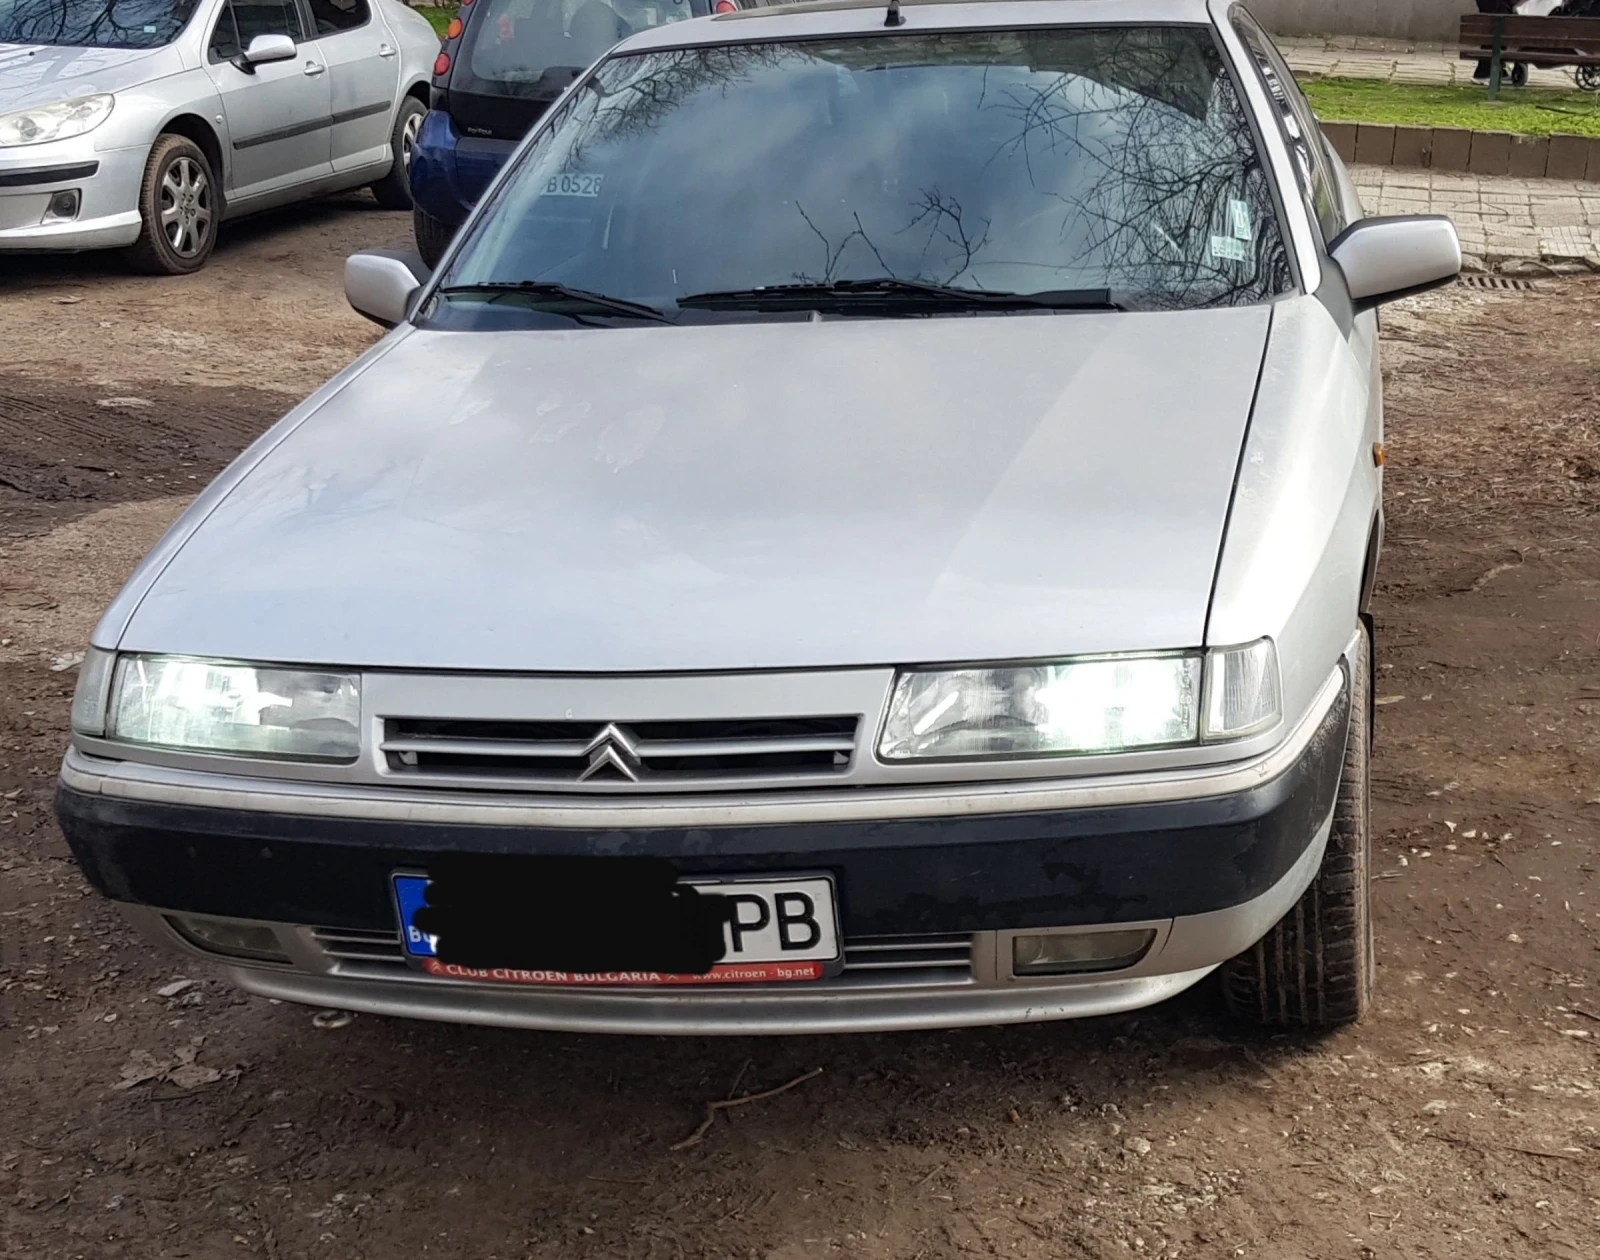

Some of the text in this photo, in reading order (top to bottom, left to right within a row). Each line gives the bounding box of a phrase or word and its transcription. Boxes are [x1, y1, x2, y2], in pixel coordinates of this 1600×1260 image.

[726, 891, 821, 952] PB
[446, 964, 661, 982] CLUB CITROEN BULGARIA
[777, 967, 815, 979] bg.net
